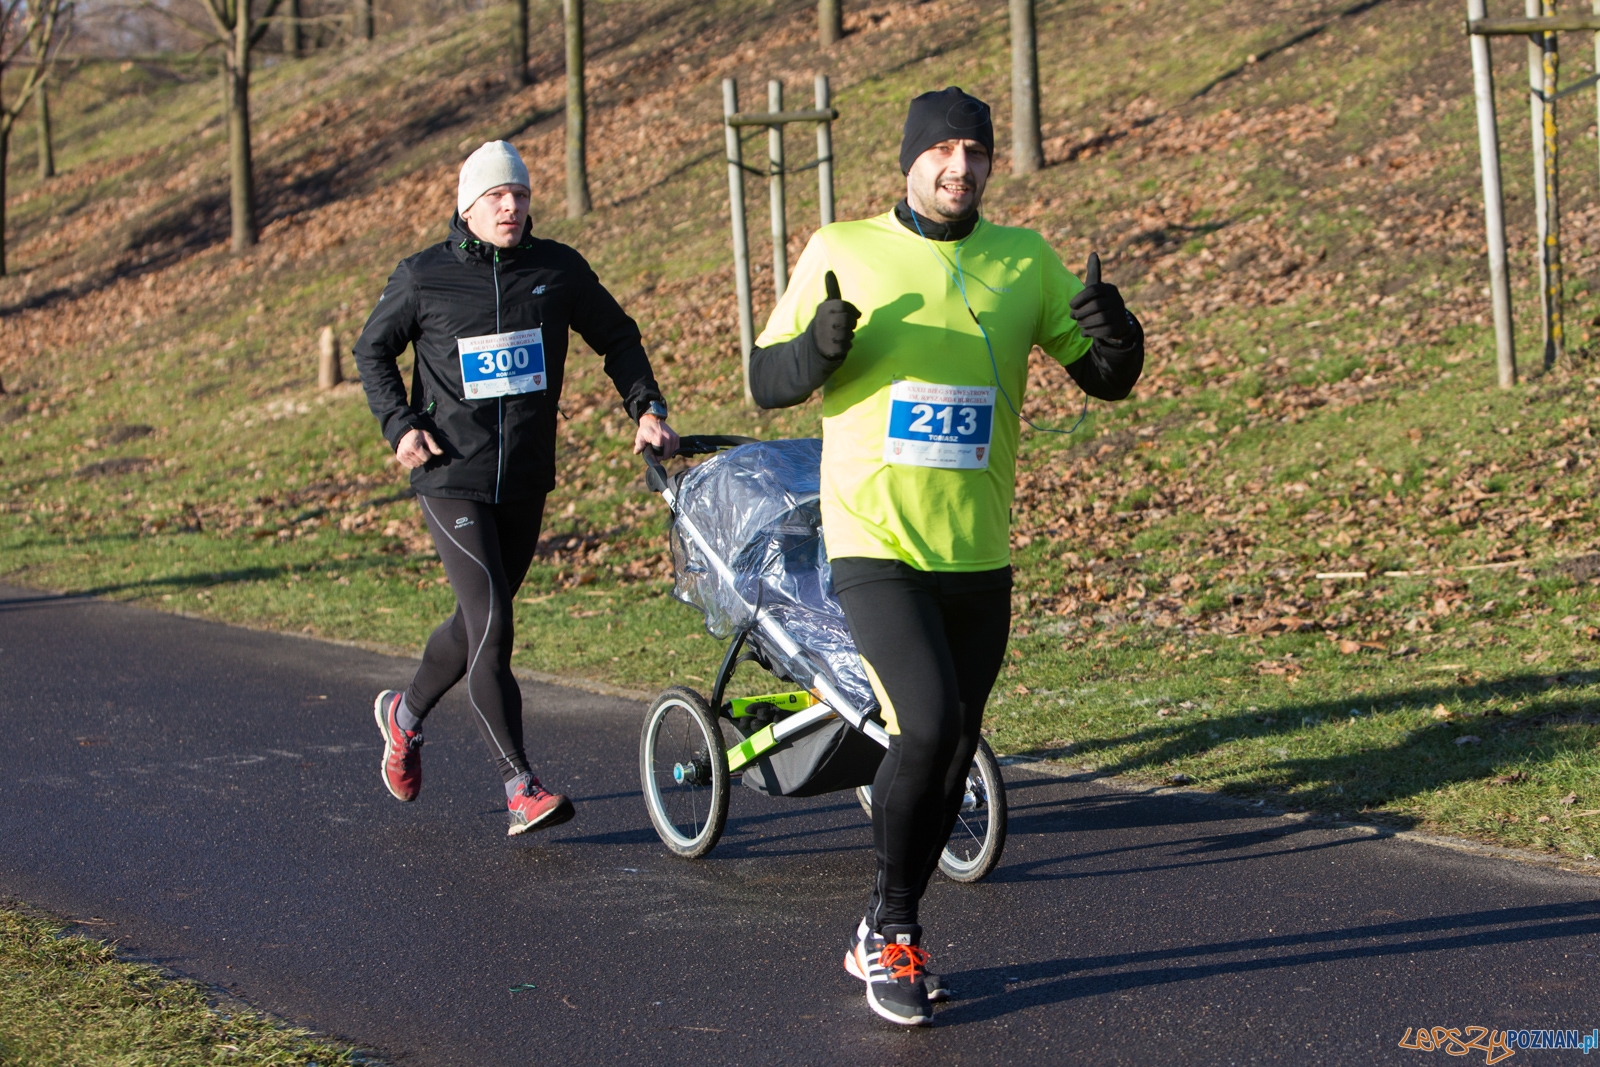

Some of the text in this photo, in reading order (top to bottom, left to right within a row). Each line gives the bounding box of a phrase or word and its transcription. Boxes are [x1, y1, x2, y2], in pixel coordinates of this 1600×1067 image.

[532, 285, 546, 295] 4F
[477, 347, 529, 374] 300
[496, 370, 516, 378] ROMAN
[945, 388, 990, 396] SYLWESTROWY
[908, 404, 977, 435] 213
